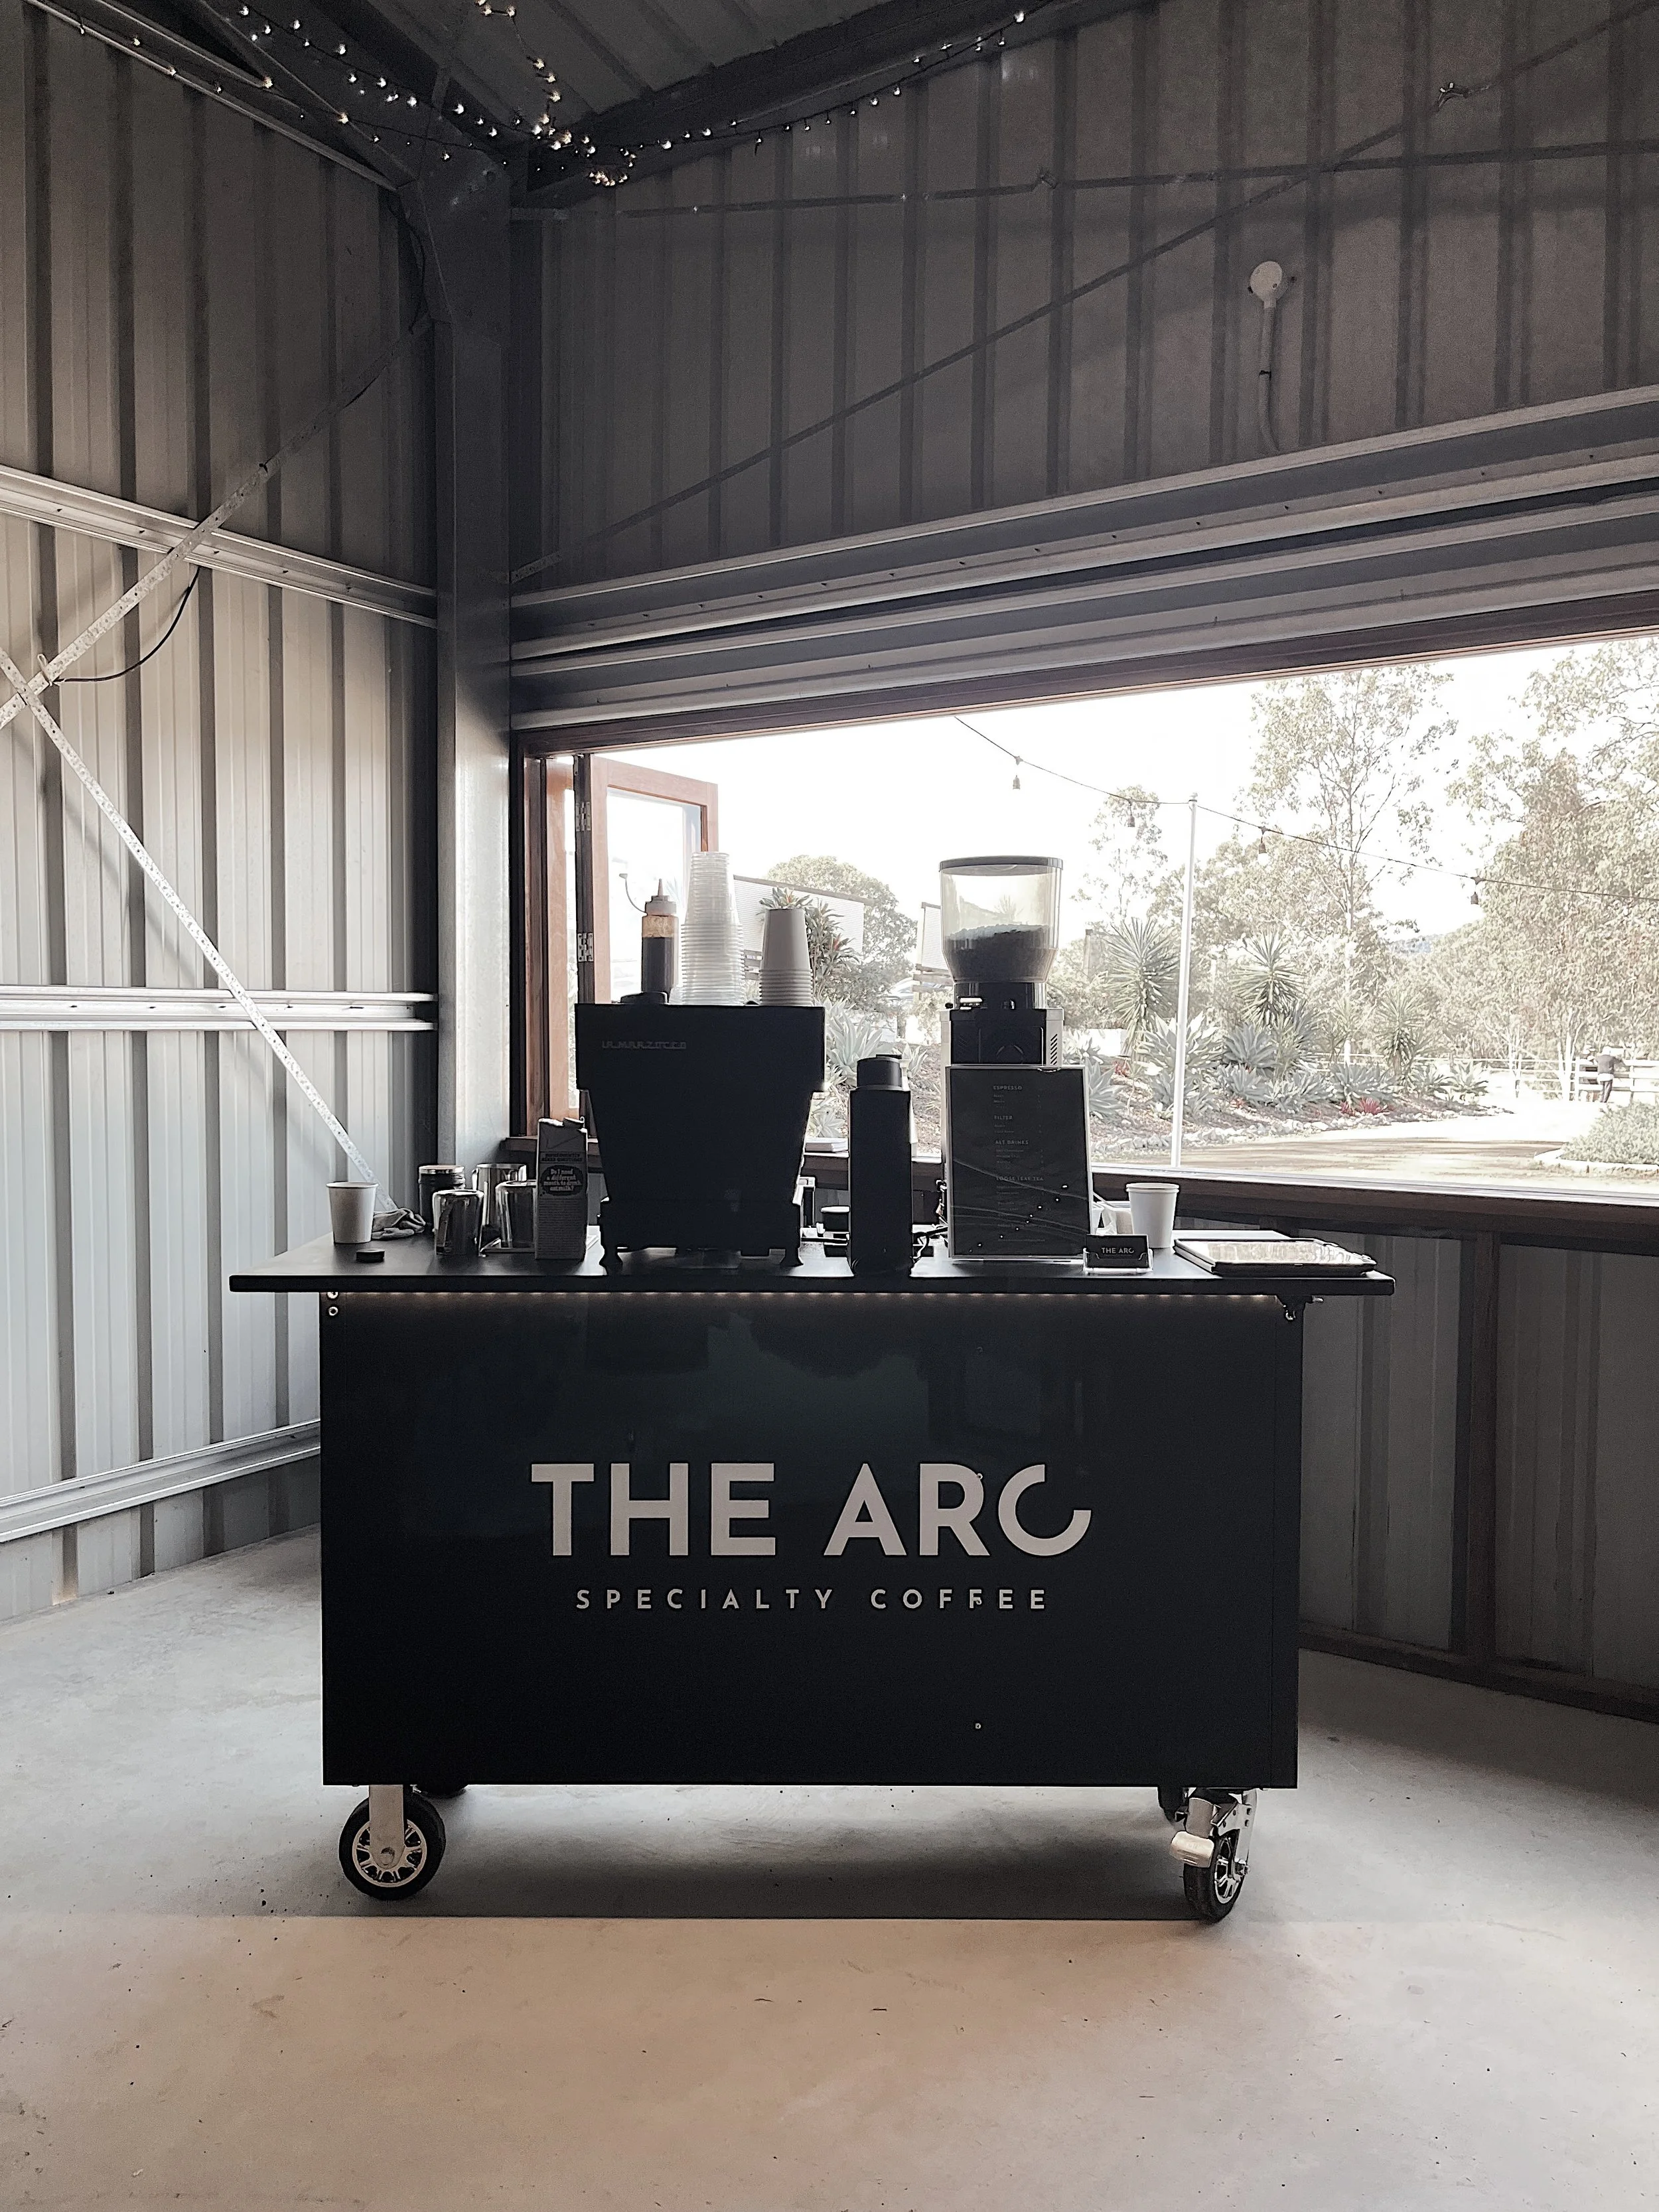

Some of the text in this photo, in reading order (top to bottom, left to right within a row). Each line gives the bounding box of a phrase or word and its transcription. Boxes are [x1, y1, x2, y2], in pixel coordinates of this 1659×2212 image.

[531, 1463, 1092, 1558] THE ARC
[576, 1588, 1047, 1611] SPECIALTY COFFEE
